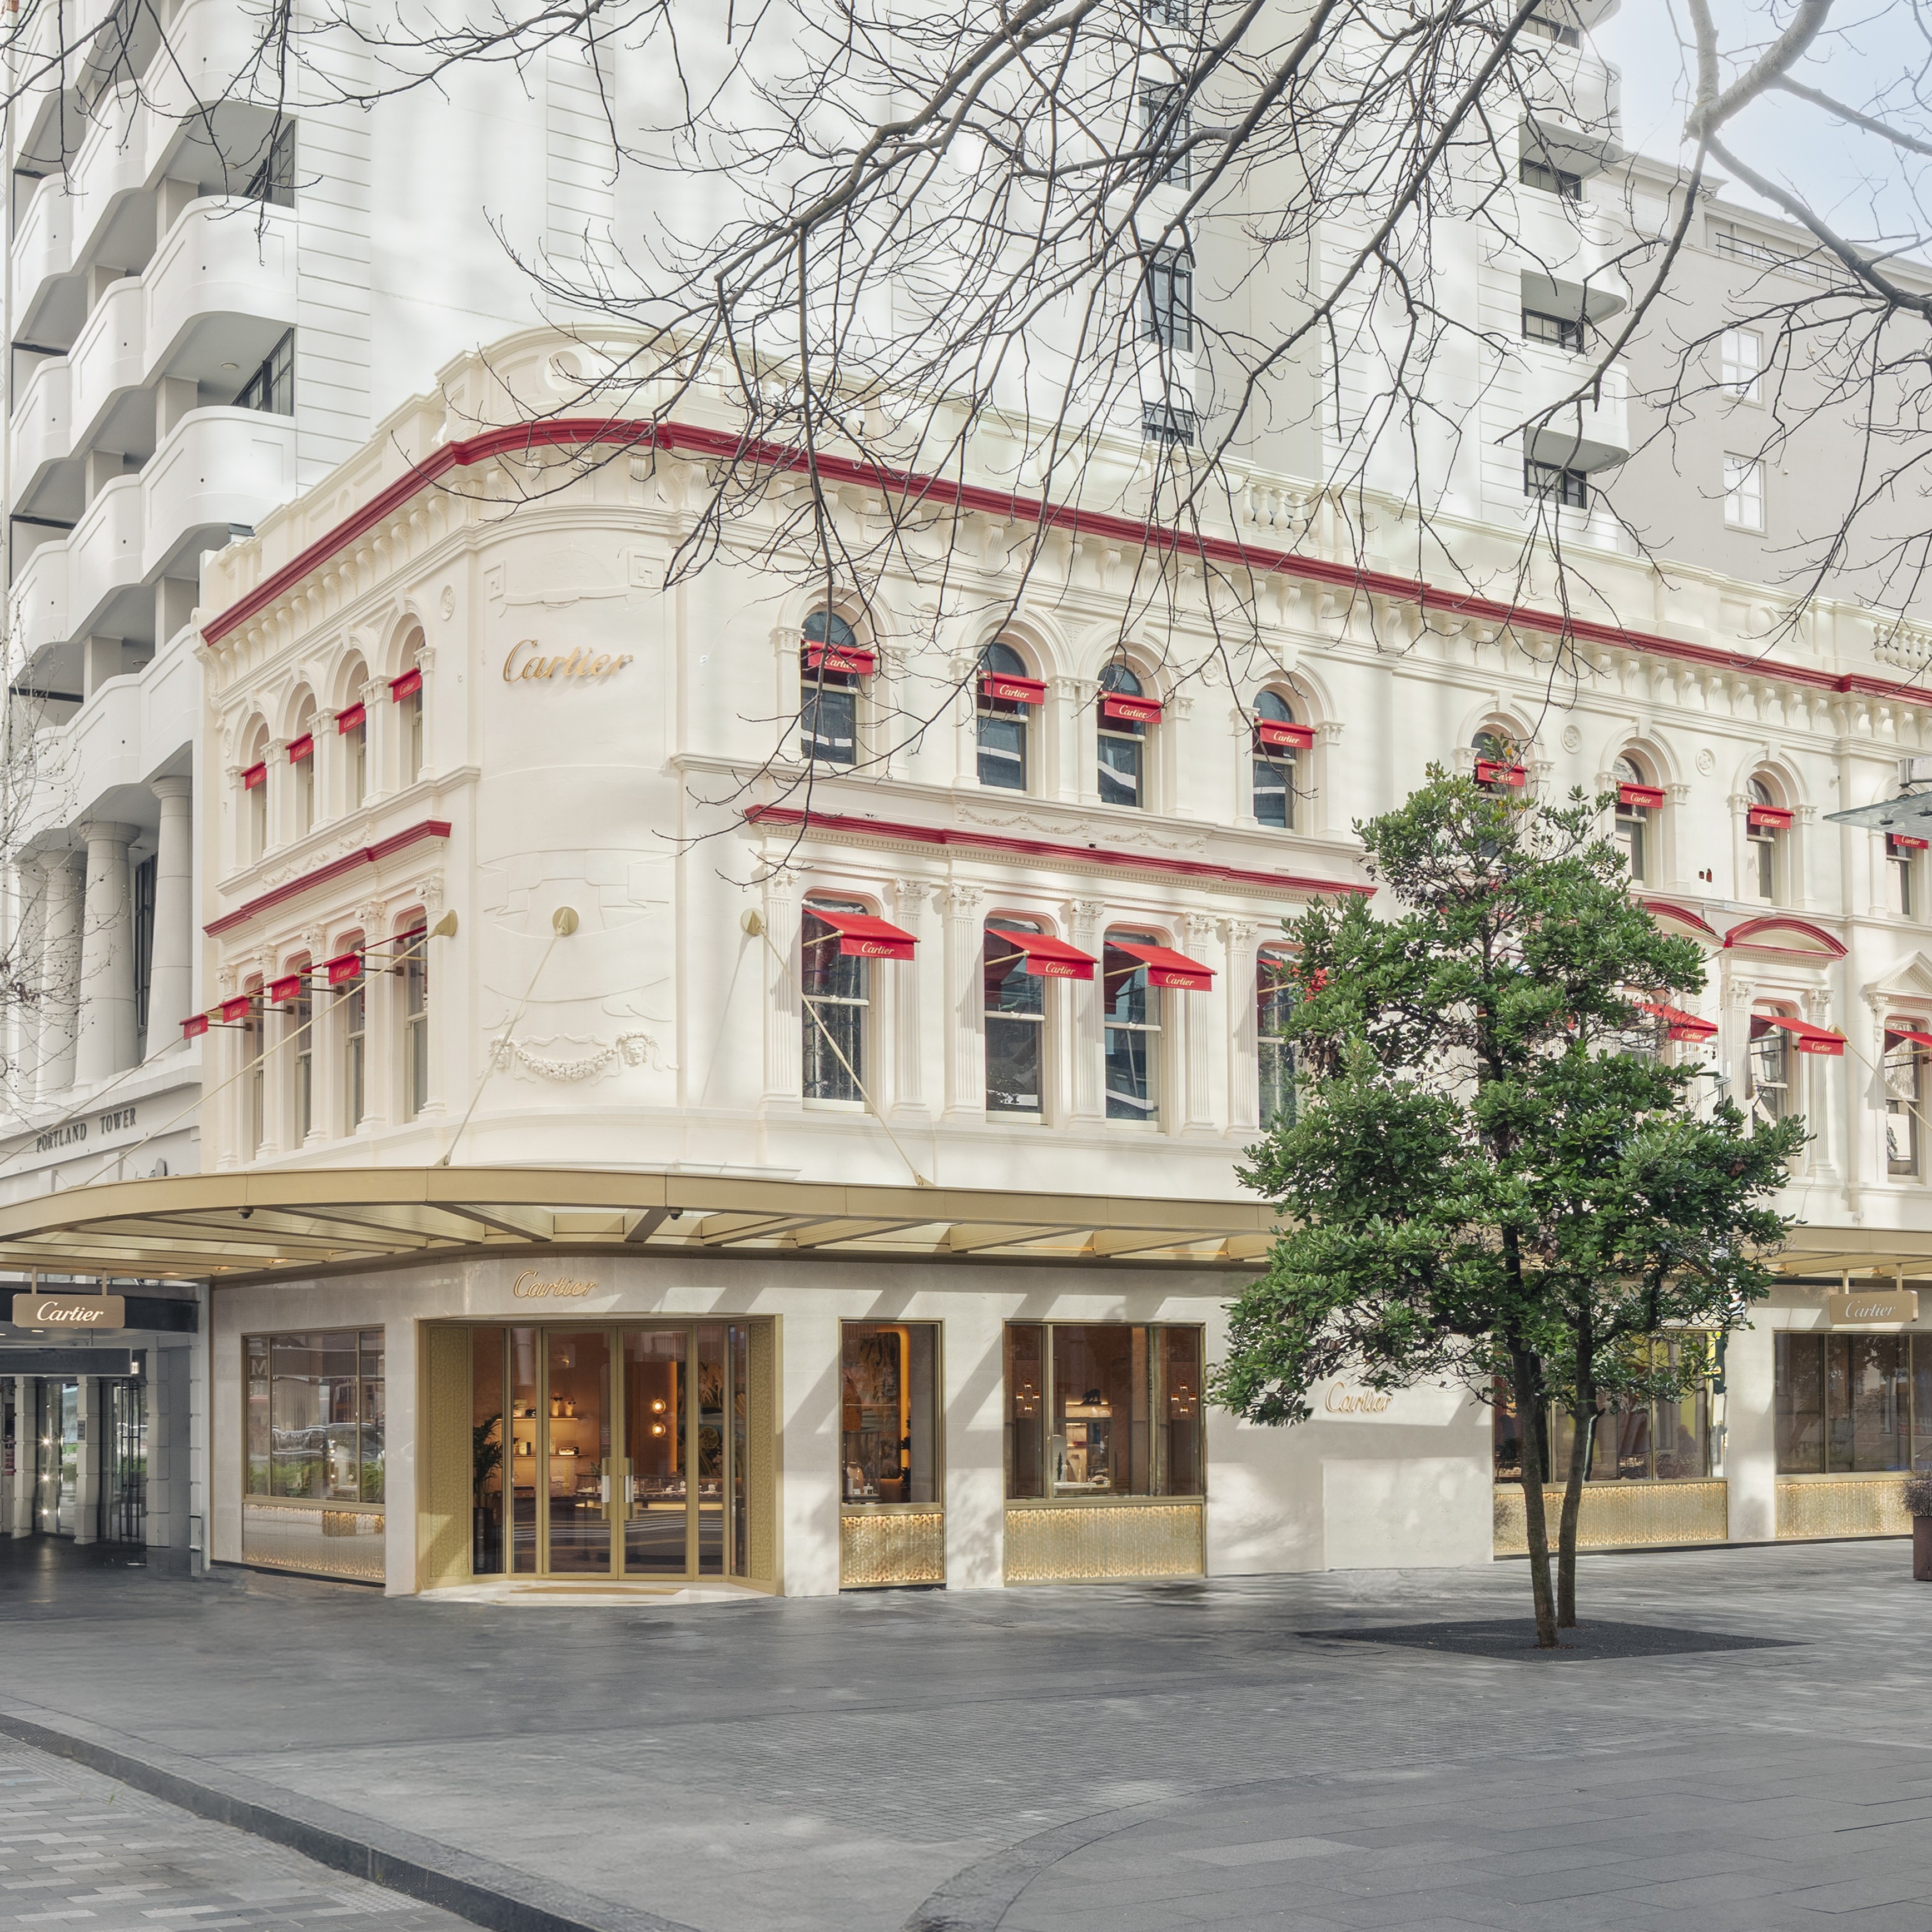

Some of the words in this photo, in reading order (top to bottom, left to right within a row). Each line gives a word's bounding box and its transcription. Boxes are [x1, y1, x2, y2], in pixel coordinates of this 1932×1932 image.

[503, 639, 634, 683] Cartier
[1000, 684, 1029, 698] Cartier
[1119, 704, 1147, 718] Cartier
[1273, 731, 1300, 744] Cartier
[1630, 792, 1652, 804] Cartier
[1760, 814, 1781, 825] Cartier
[1901, 836, 1920, 845] Cartier
[861, 941, 895, 955] Cartier
[1045, 962, 1075, 975] Cartier
[1165, 974, 1194, 986] Cartier
[1681, 1029, 1703, 1040] Cartier
[1811, 1041, 1832, 1052] Cartier
[36, 1123, 87, 1153] PORTLAND
[100, 1107, 136, 1134] TOWER
[514, 1270, 598, 1298] Cartier
[37, 1301, 104, 1322] Cartier
[1845, 1300, 1895, 1318] Cartier
[1326, 1380, 1393, 1412] Cartier
